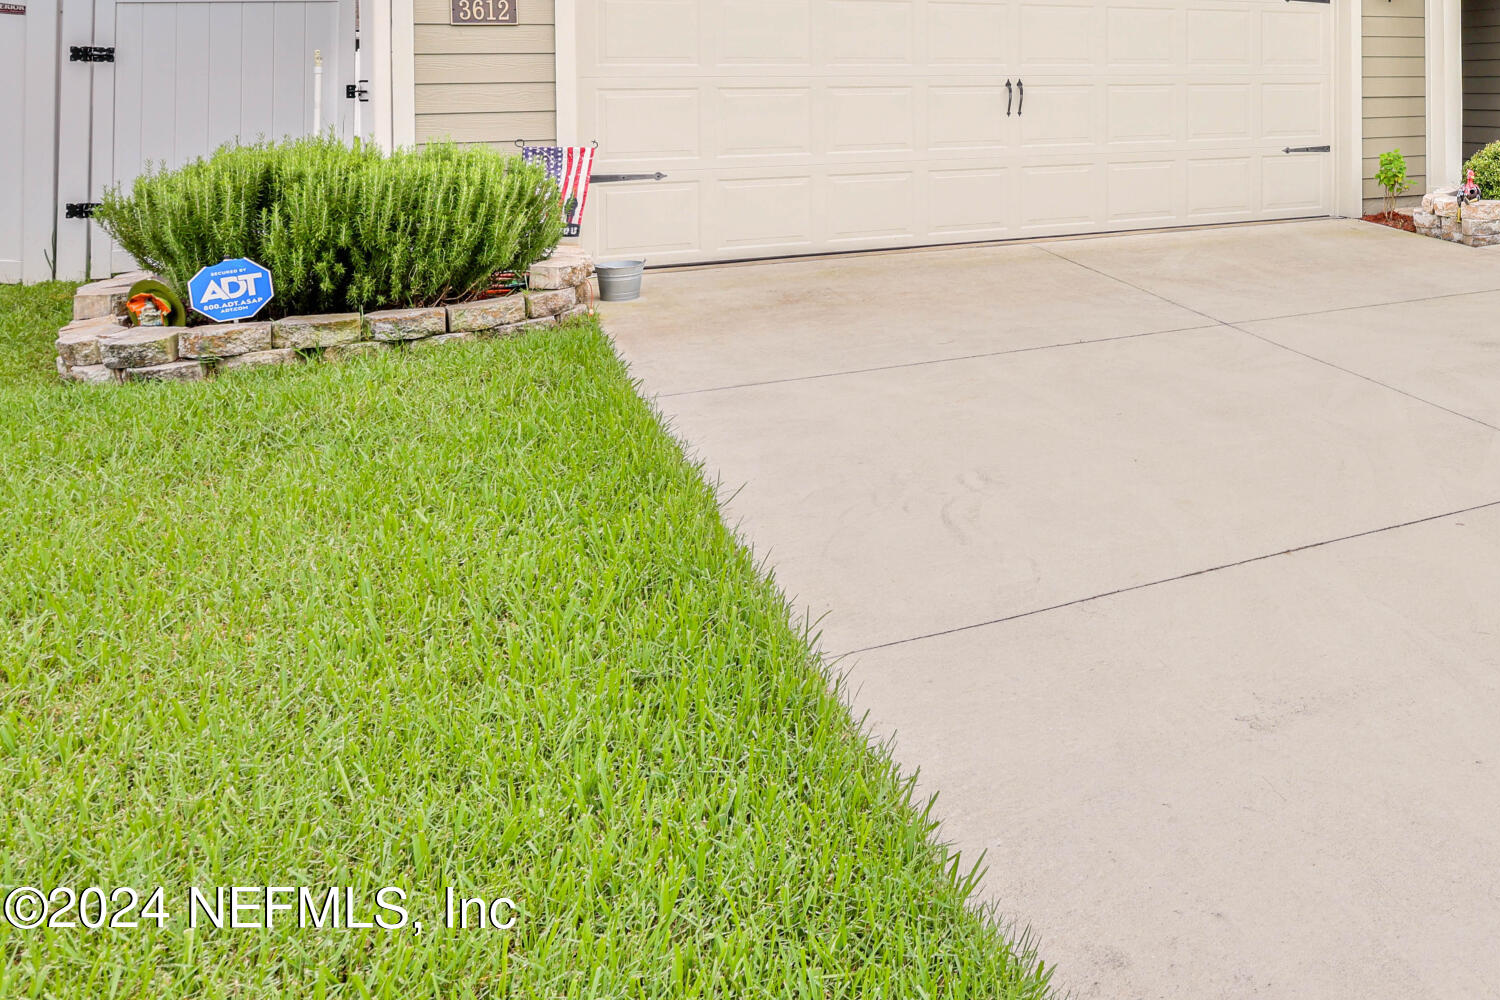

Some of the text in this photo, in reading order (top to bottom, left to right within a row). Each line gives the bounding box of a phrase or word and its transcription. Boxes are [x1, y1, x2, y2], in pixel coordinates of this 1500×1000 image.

[459, 0, 510, 20] 3612
[211, 269, 238, 277] SECURED
[200, 272, 263, 304] ADT
